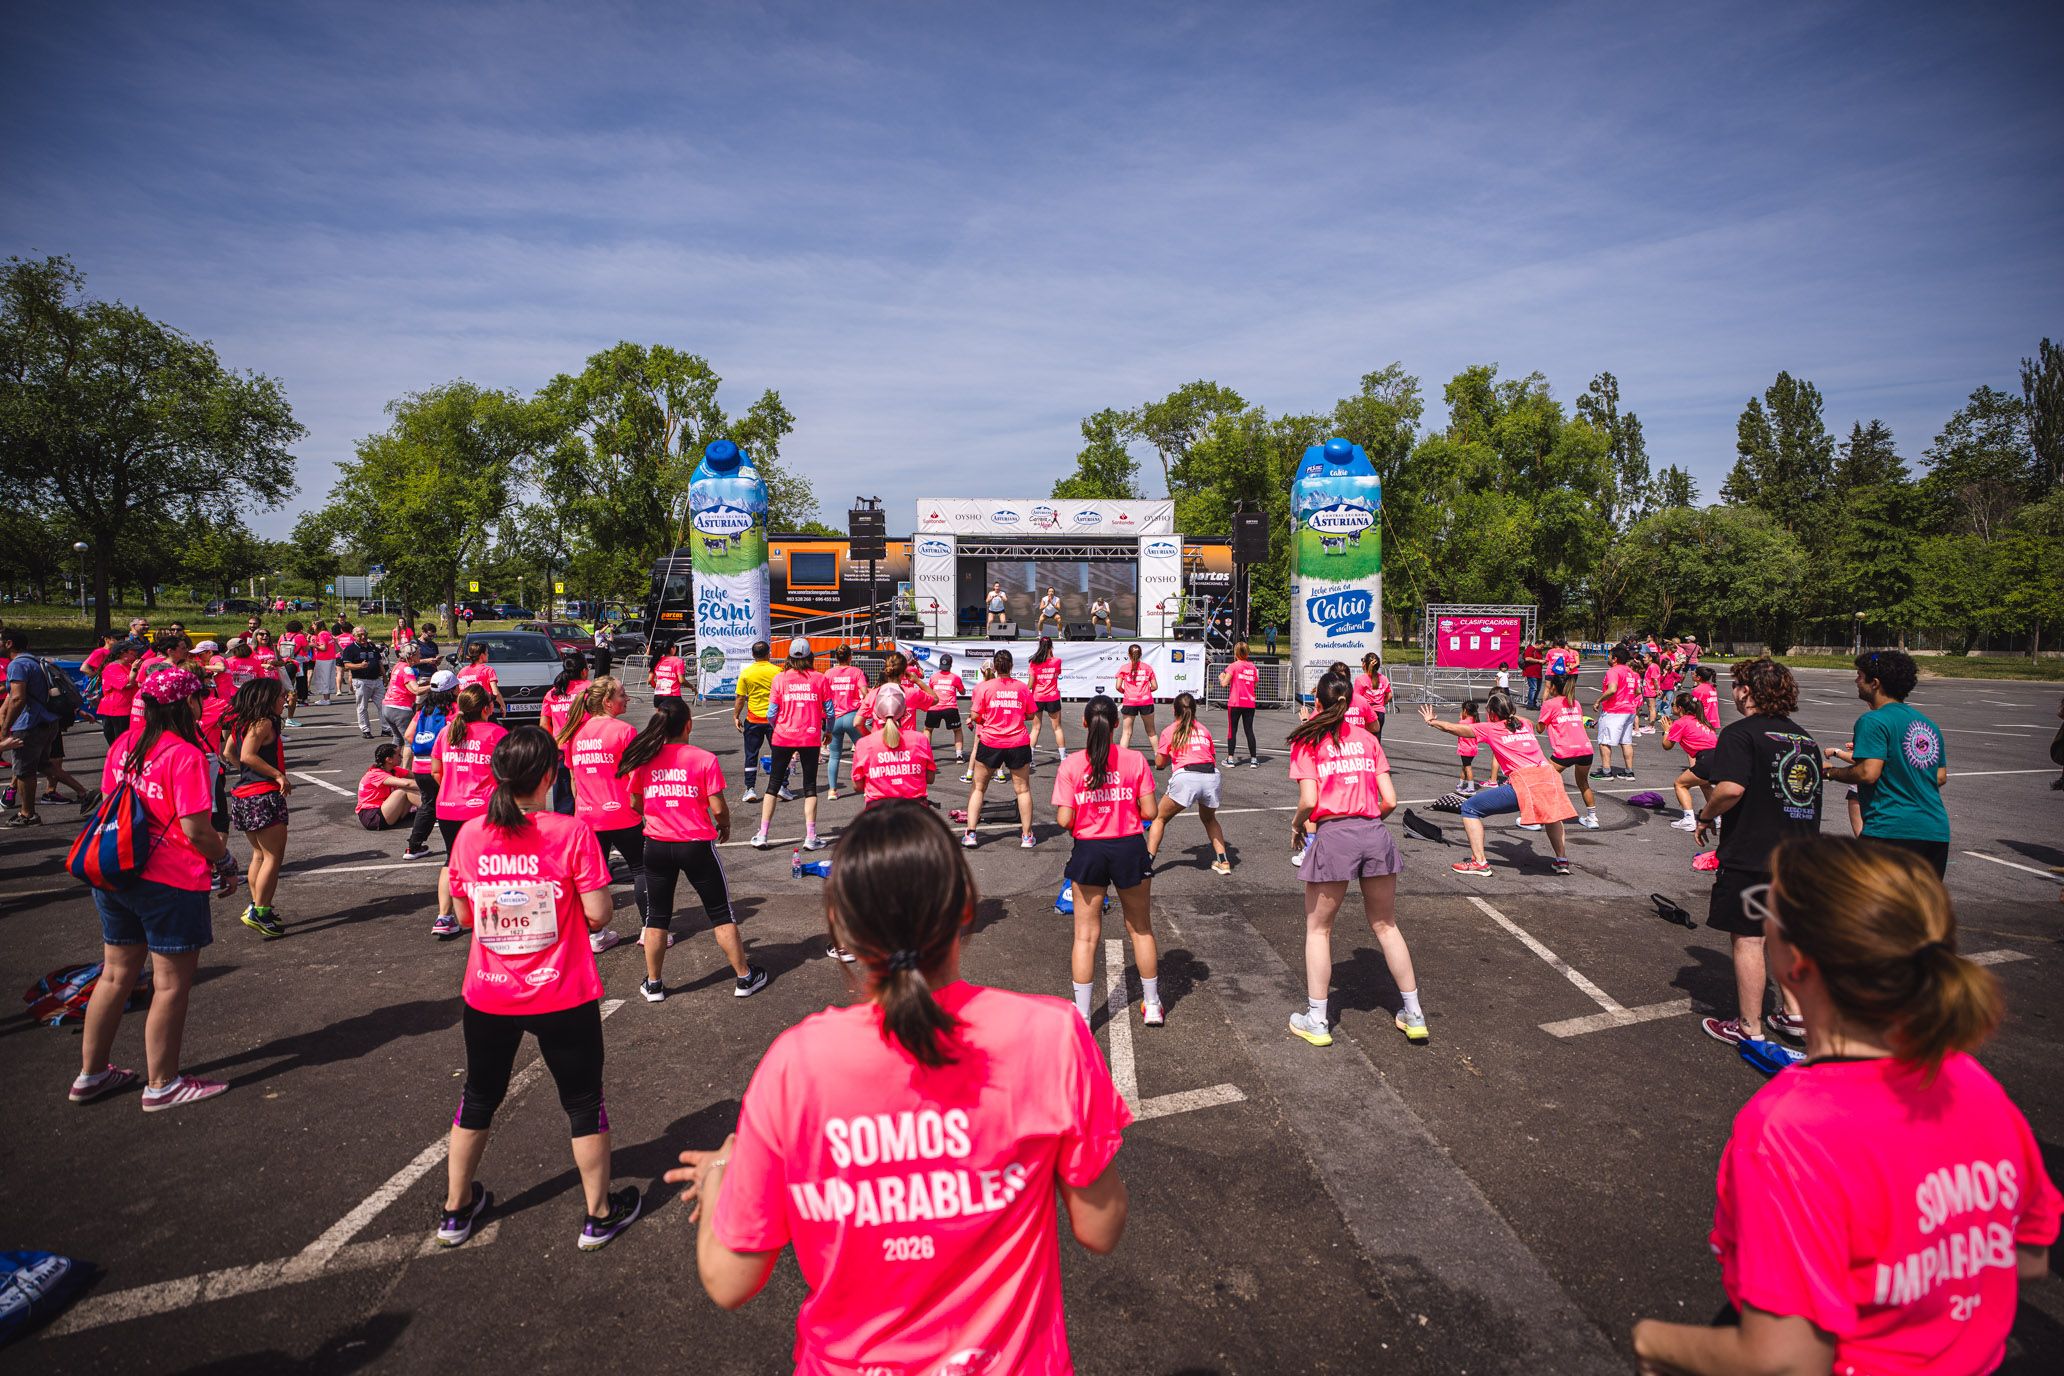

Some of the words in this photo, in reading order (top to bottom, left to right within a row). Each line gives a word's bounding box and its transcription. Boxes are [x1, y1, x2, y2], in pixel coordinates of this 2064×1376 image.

[697, 516, 749, 528] ASTURIANA
[1313, 515, 1369, 527] ASTURIANA
[921, 546, 949, 554] ASTURIANA
[1147, 547, 1175, 555] ASTURIANA
[919, 574, 950, 582] OYSHO
[1145, 575, 1177, 583] OYSHO
[699, 585, 729, 602] Leche
[1311, 586, 1327, 597] Leche
[698, 598, 756, 623] semi
[1312, 596, 1366, 623] Calcio
[699, 621, 758, 637] desnatada
[1336, 621, 1365, 633] natural
[1314, 641, 1365, 649] semidesnatada
[789, 683, 811, 692] SOMOS
[996, 690, 1018, 699] SOMOS
[577, 738, 603, 752] SOMOS
[877, 750, 911, 764] SOMOS
[869, 763, 922, 780] IMPARABLES
[1317, 757, 1376, 778] IMPARABLES
[651, 768, 687, 783] SOMOS
[478, 854, 539, 876] SOMOS
[501, 917, 530, 928] 016
[825, 1108, 972, 1169] SOMOS
[788, 1162, 1026, 1228] IMPARABLES
[1916, 1159, 2020, 1234] SOMOS
[883, 1235, 935, 1262] 2026
